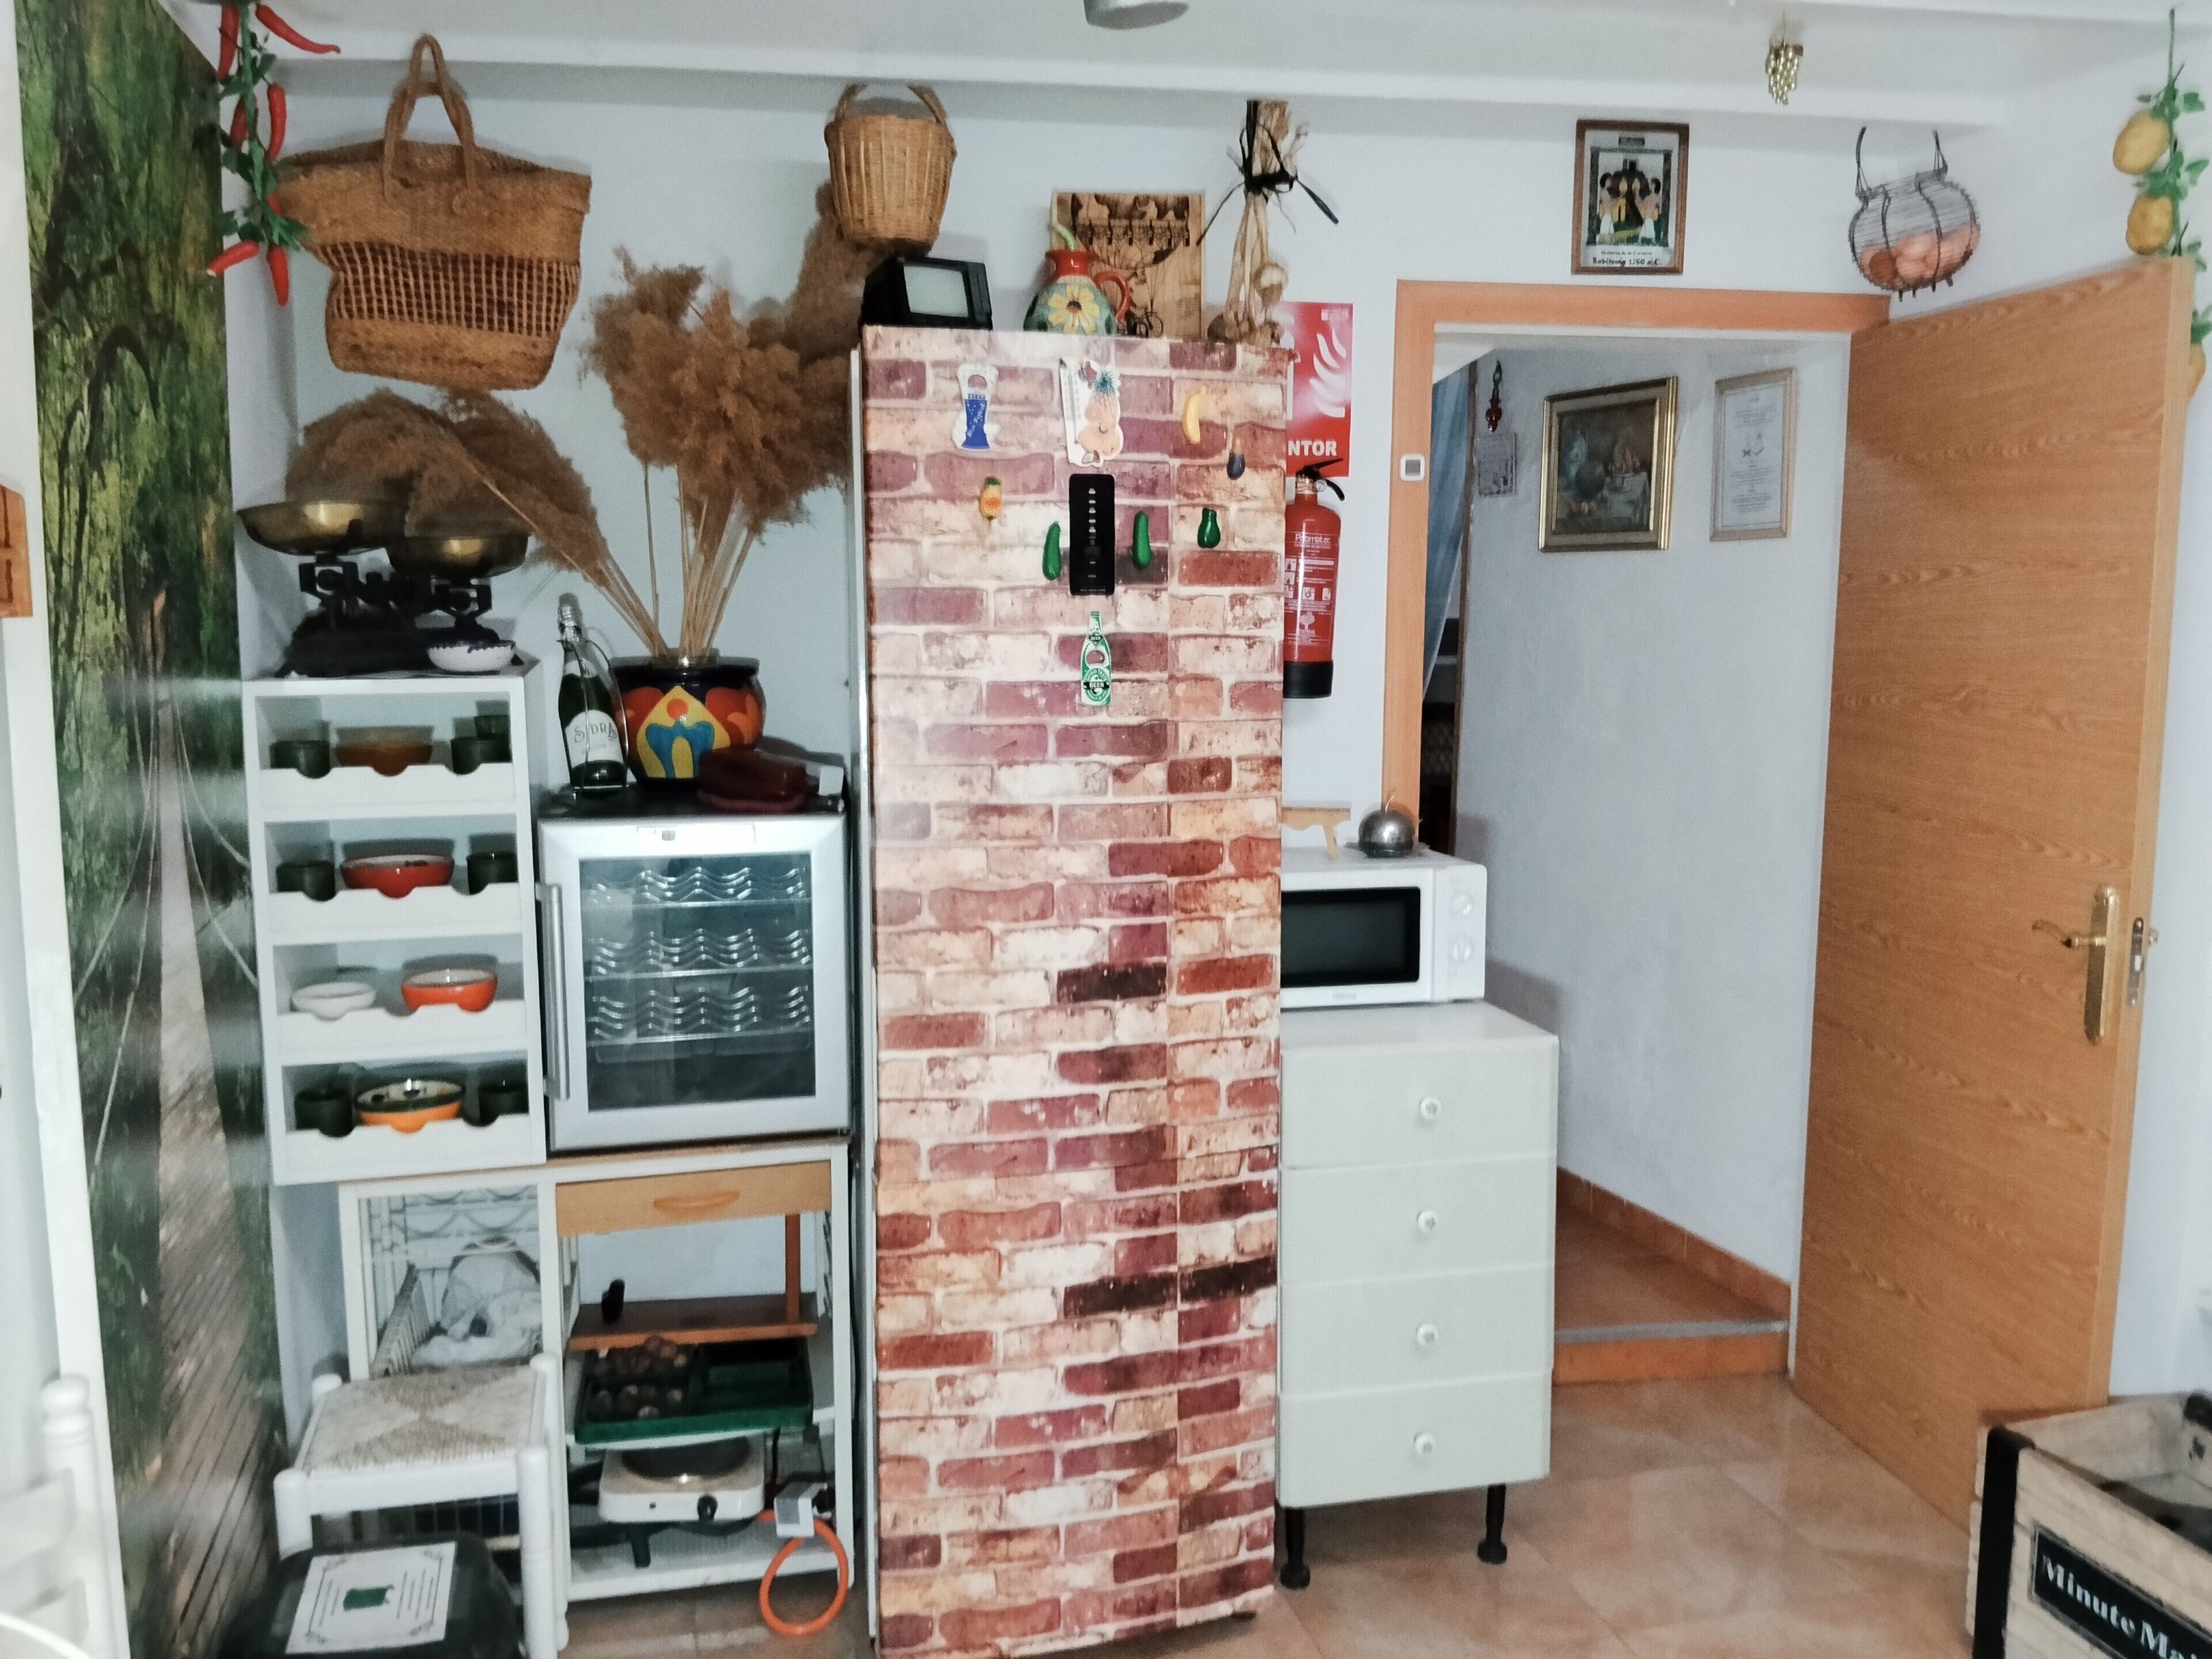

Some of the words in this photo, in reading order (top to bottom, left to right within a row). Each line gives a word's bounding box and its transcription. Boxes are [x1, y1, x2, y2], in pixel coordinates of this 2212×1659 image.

[1288, 440, 1337, 456] NTOR
[574, 722, 618, 743] SDRA
[2043, 1555, 2135, 1638] Minute
